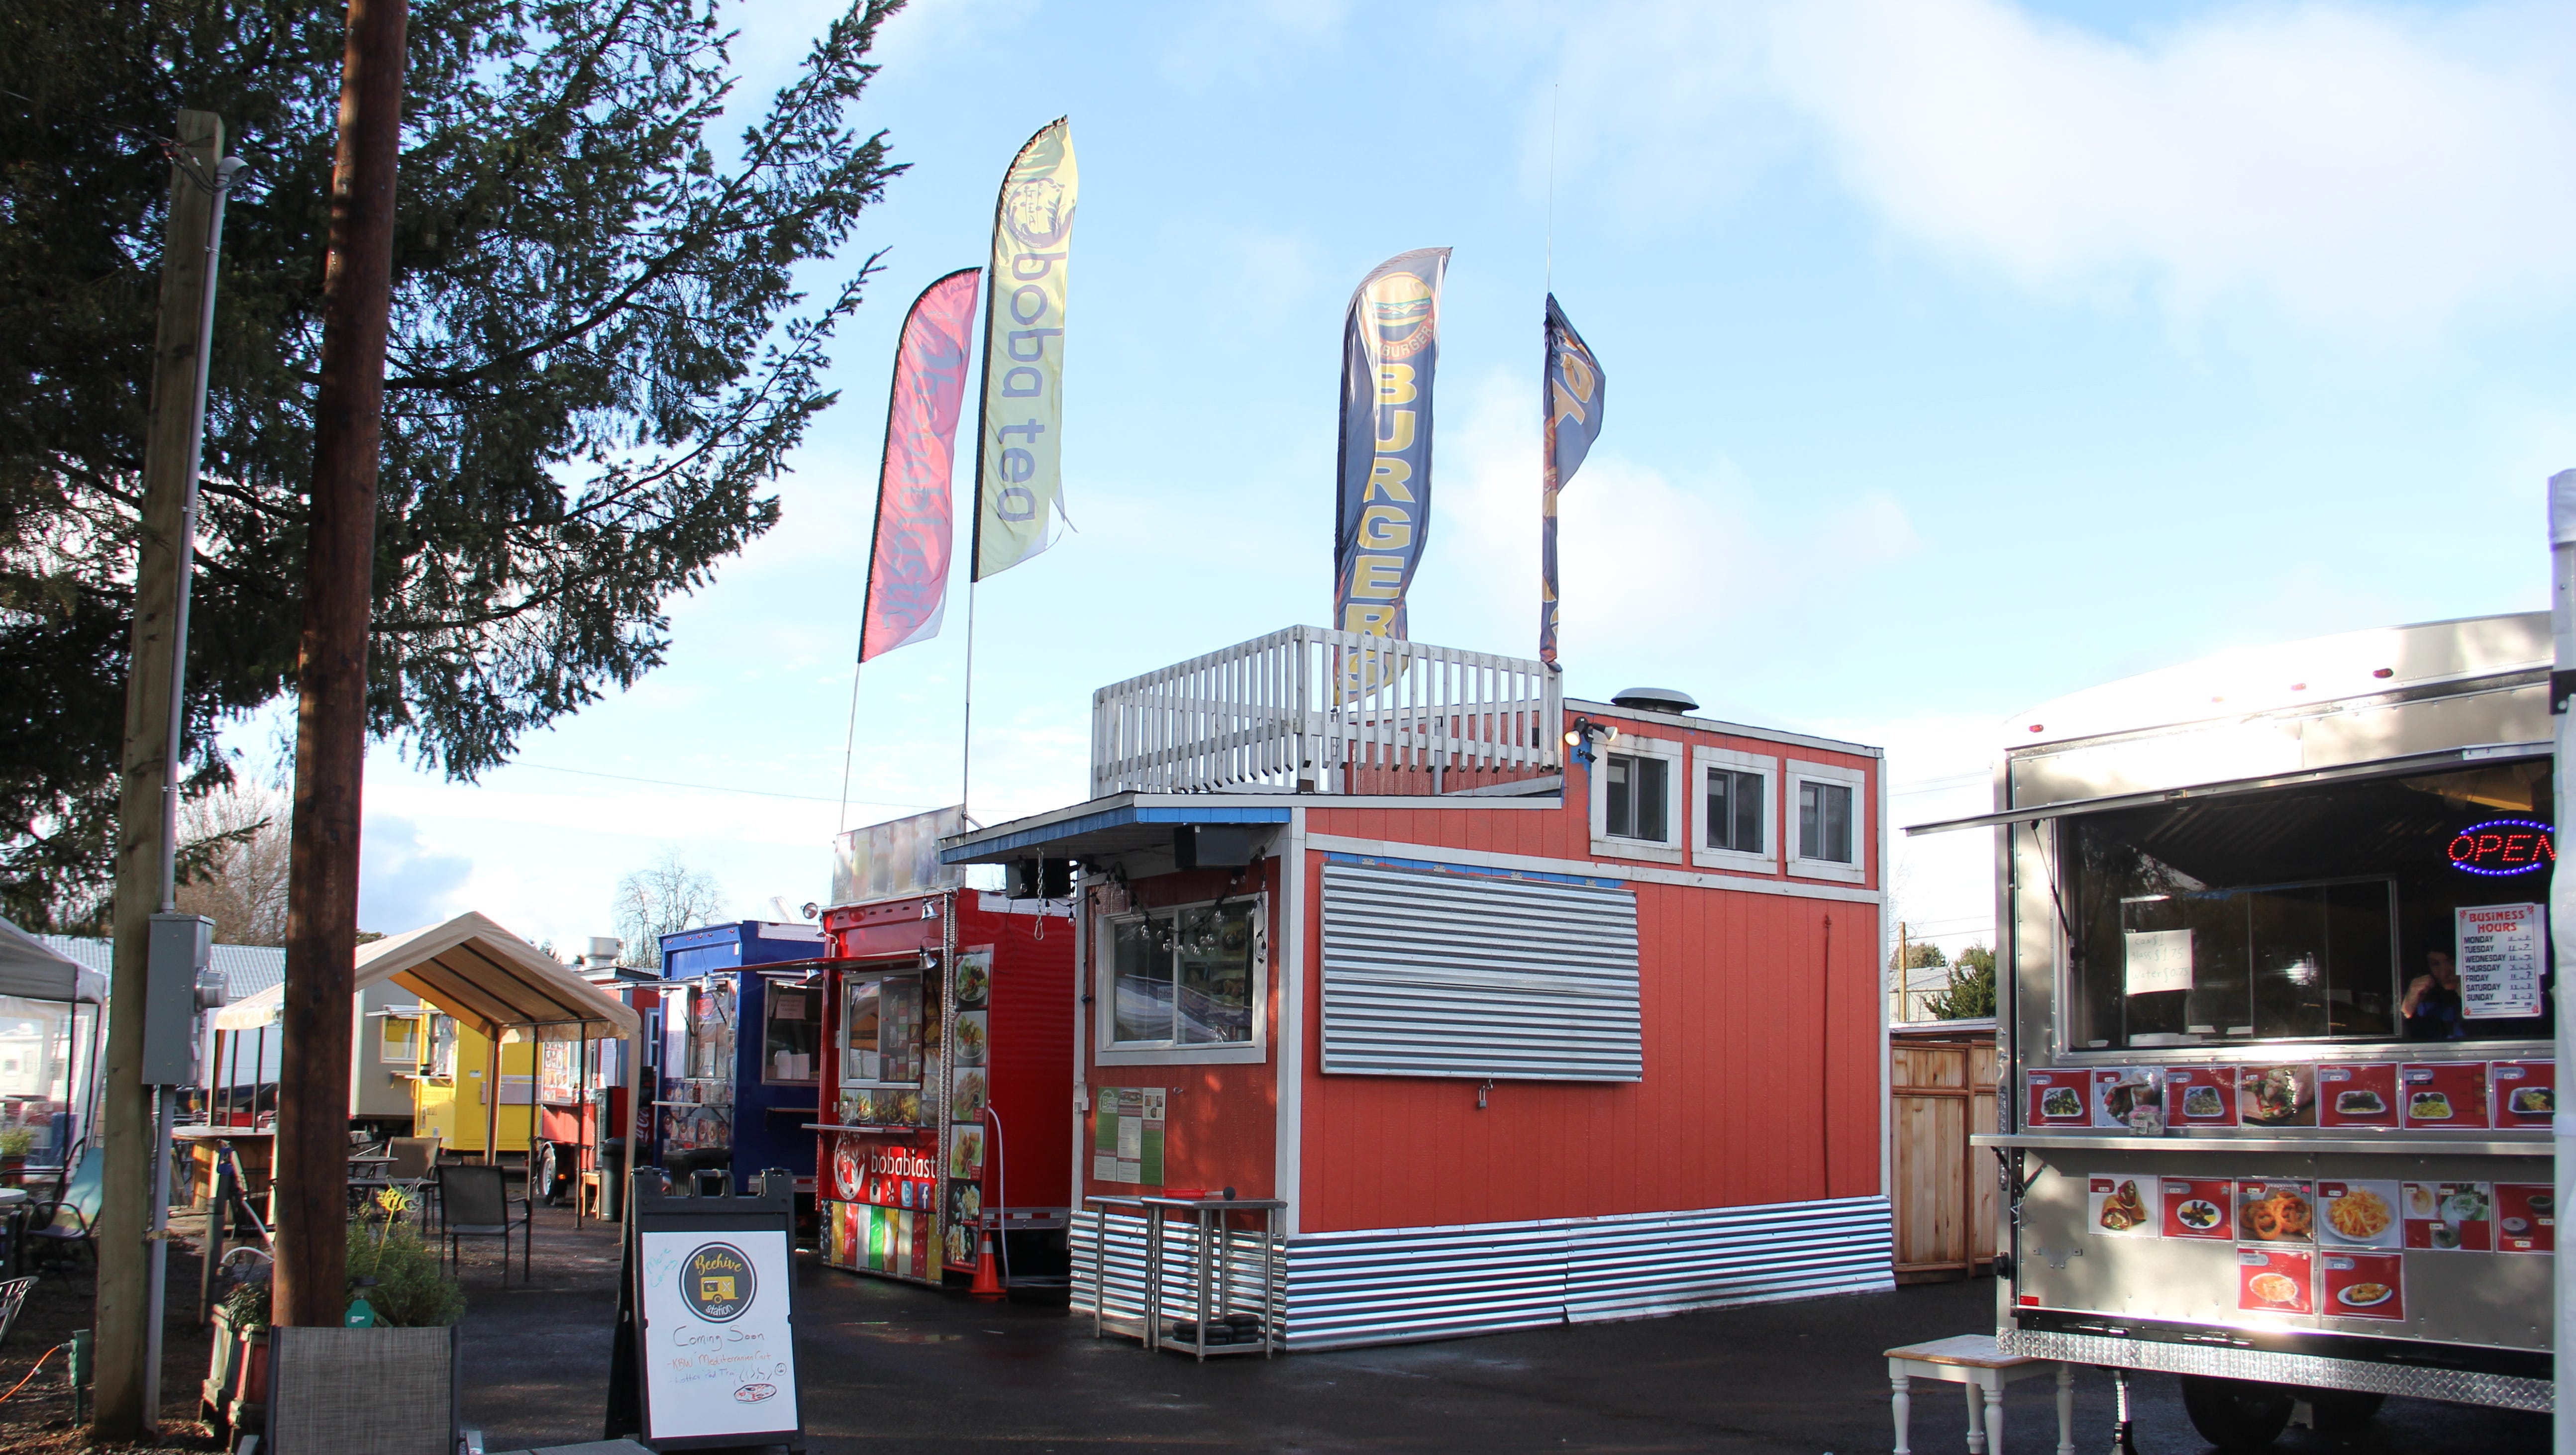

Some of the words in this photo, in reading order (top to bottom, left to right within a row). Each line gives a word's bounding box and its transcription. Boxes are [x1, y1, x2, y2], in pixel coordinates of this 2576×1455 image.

[1001, 252, 1067, 398] boba
[1382, 326, 1433, 358] BURGER
[997, 418, 1045, 523] tea
[2448, 835, 2556, 862] OPEN
[2477, 922, 2517, 934] HOURS
[2465, 964, 2500, 972] THURSDAY
[2467, 993, 2493, 1001] SUNDAY
[871, 1146, 938, 1179] bobablast
[695, 1253, 742, 1275] Beehive
[706, 1304, 734, 1316] station
[674, 1325, 723, 1352] Coming
[727, 1325, 765, 1342] Soon
[754, 1350, 772, 1360] Cart
